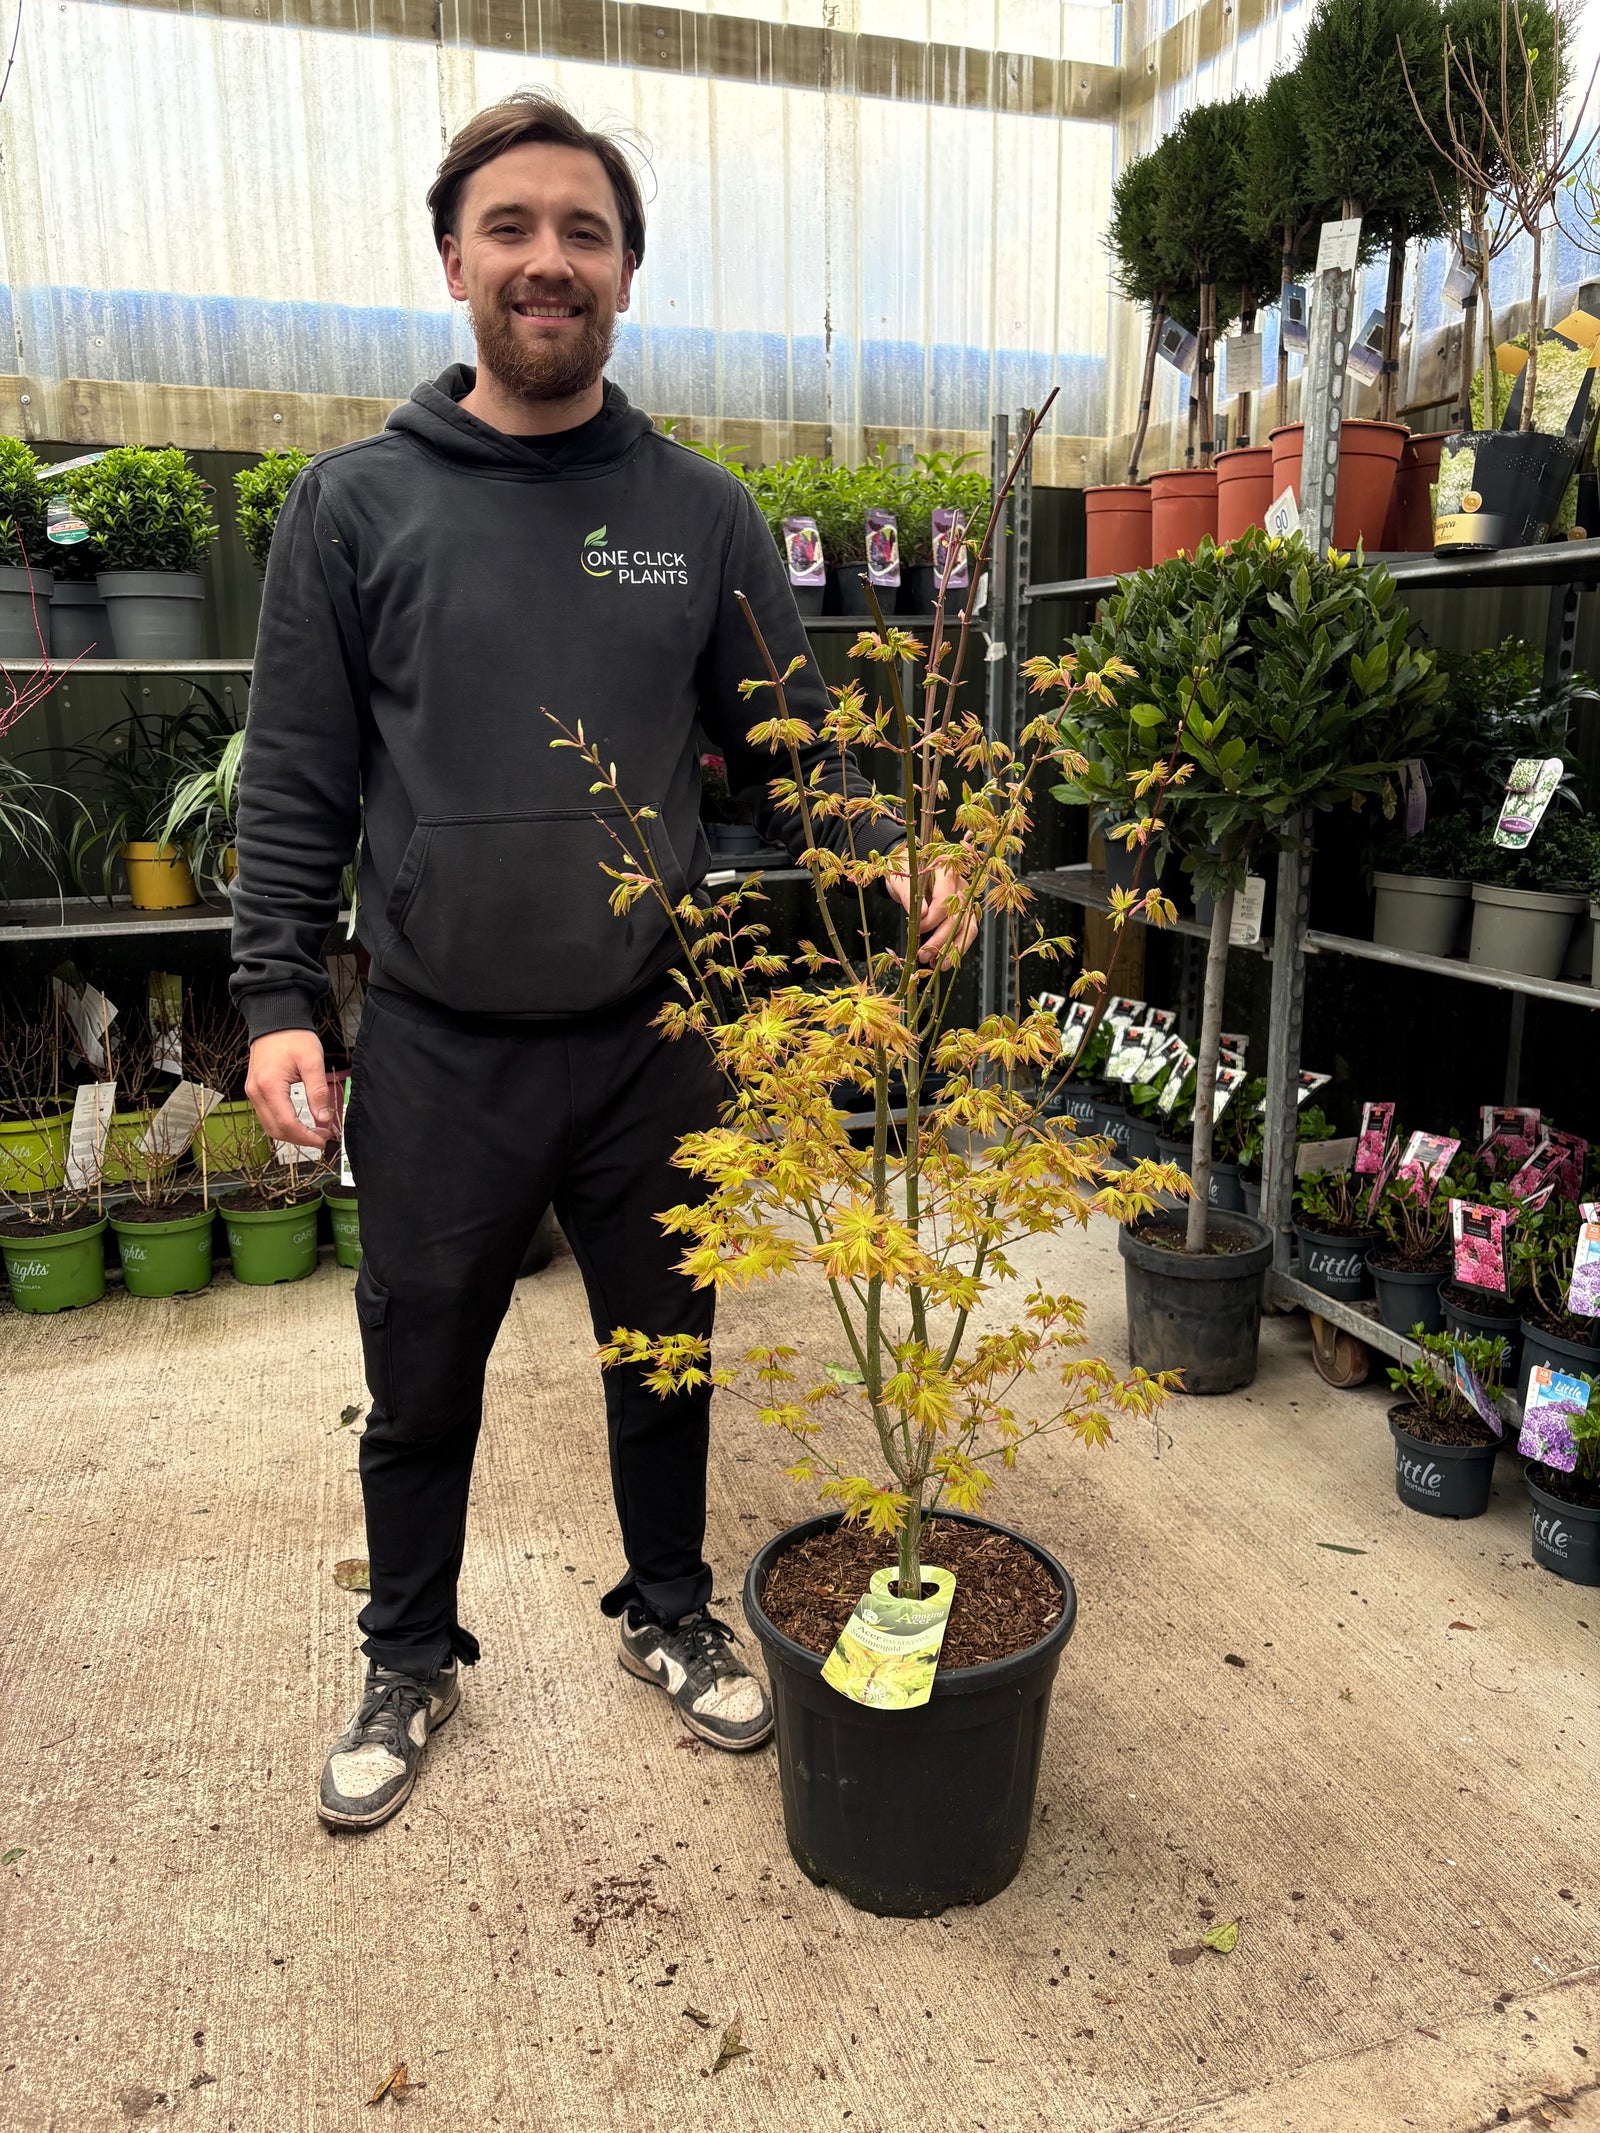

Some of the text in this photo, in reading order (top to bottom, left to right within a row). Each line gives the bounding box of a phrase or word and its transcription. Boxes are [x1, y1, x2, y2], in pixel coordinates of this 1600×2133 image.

[587, 550, 687, 567] ONE CLICK
[618, 569, 688, 585] PLANTS
[1309, 1251, 1362, 1277] Little
[1554, 1380, 1582, 1398] Little
[1395, 1446, 1442, 1488] Little
[1404, 1478, 1441, 1498] Hortensia
[1532, 1507, 1569, 1548] ittle
[858, 1626, 882, 1641] Acer
